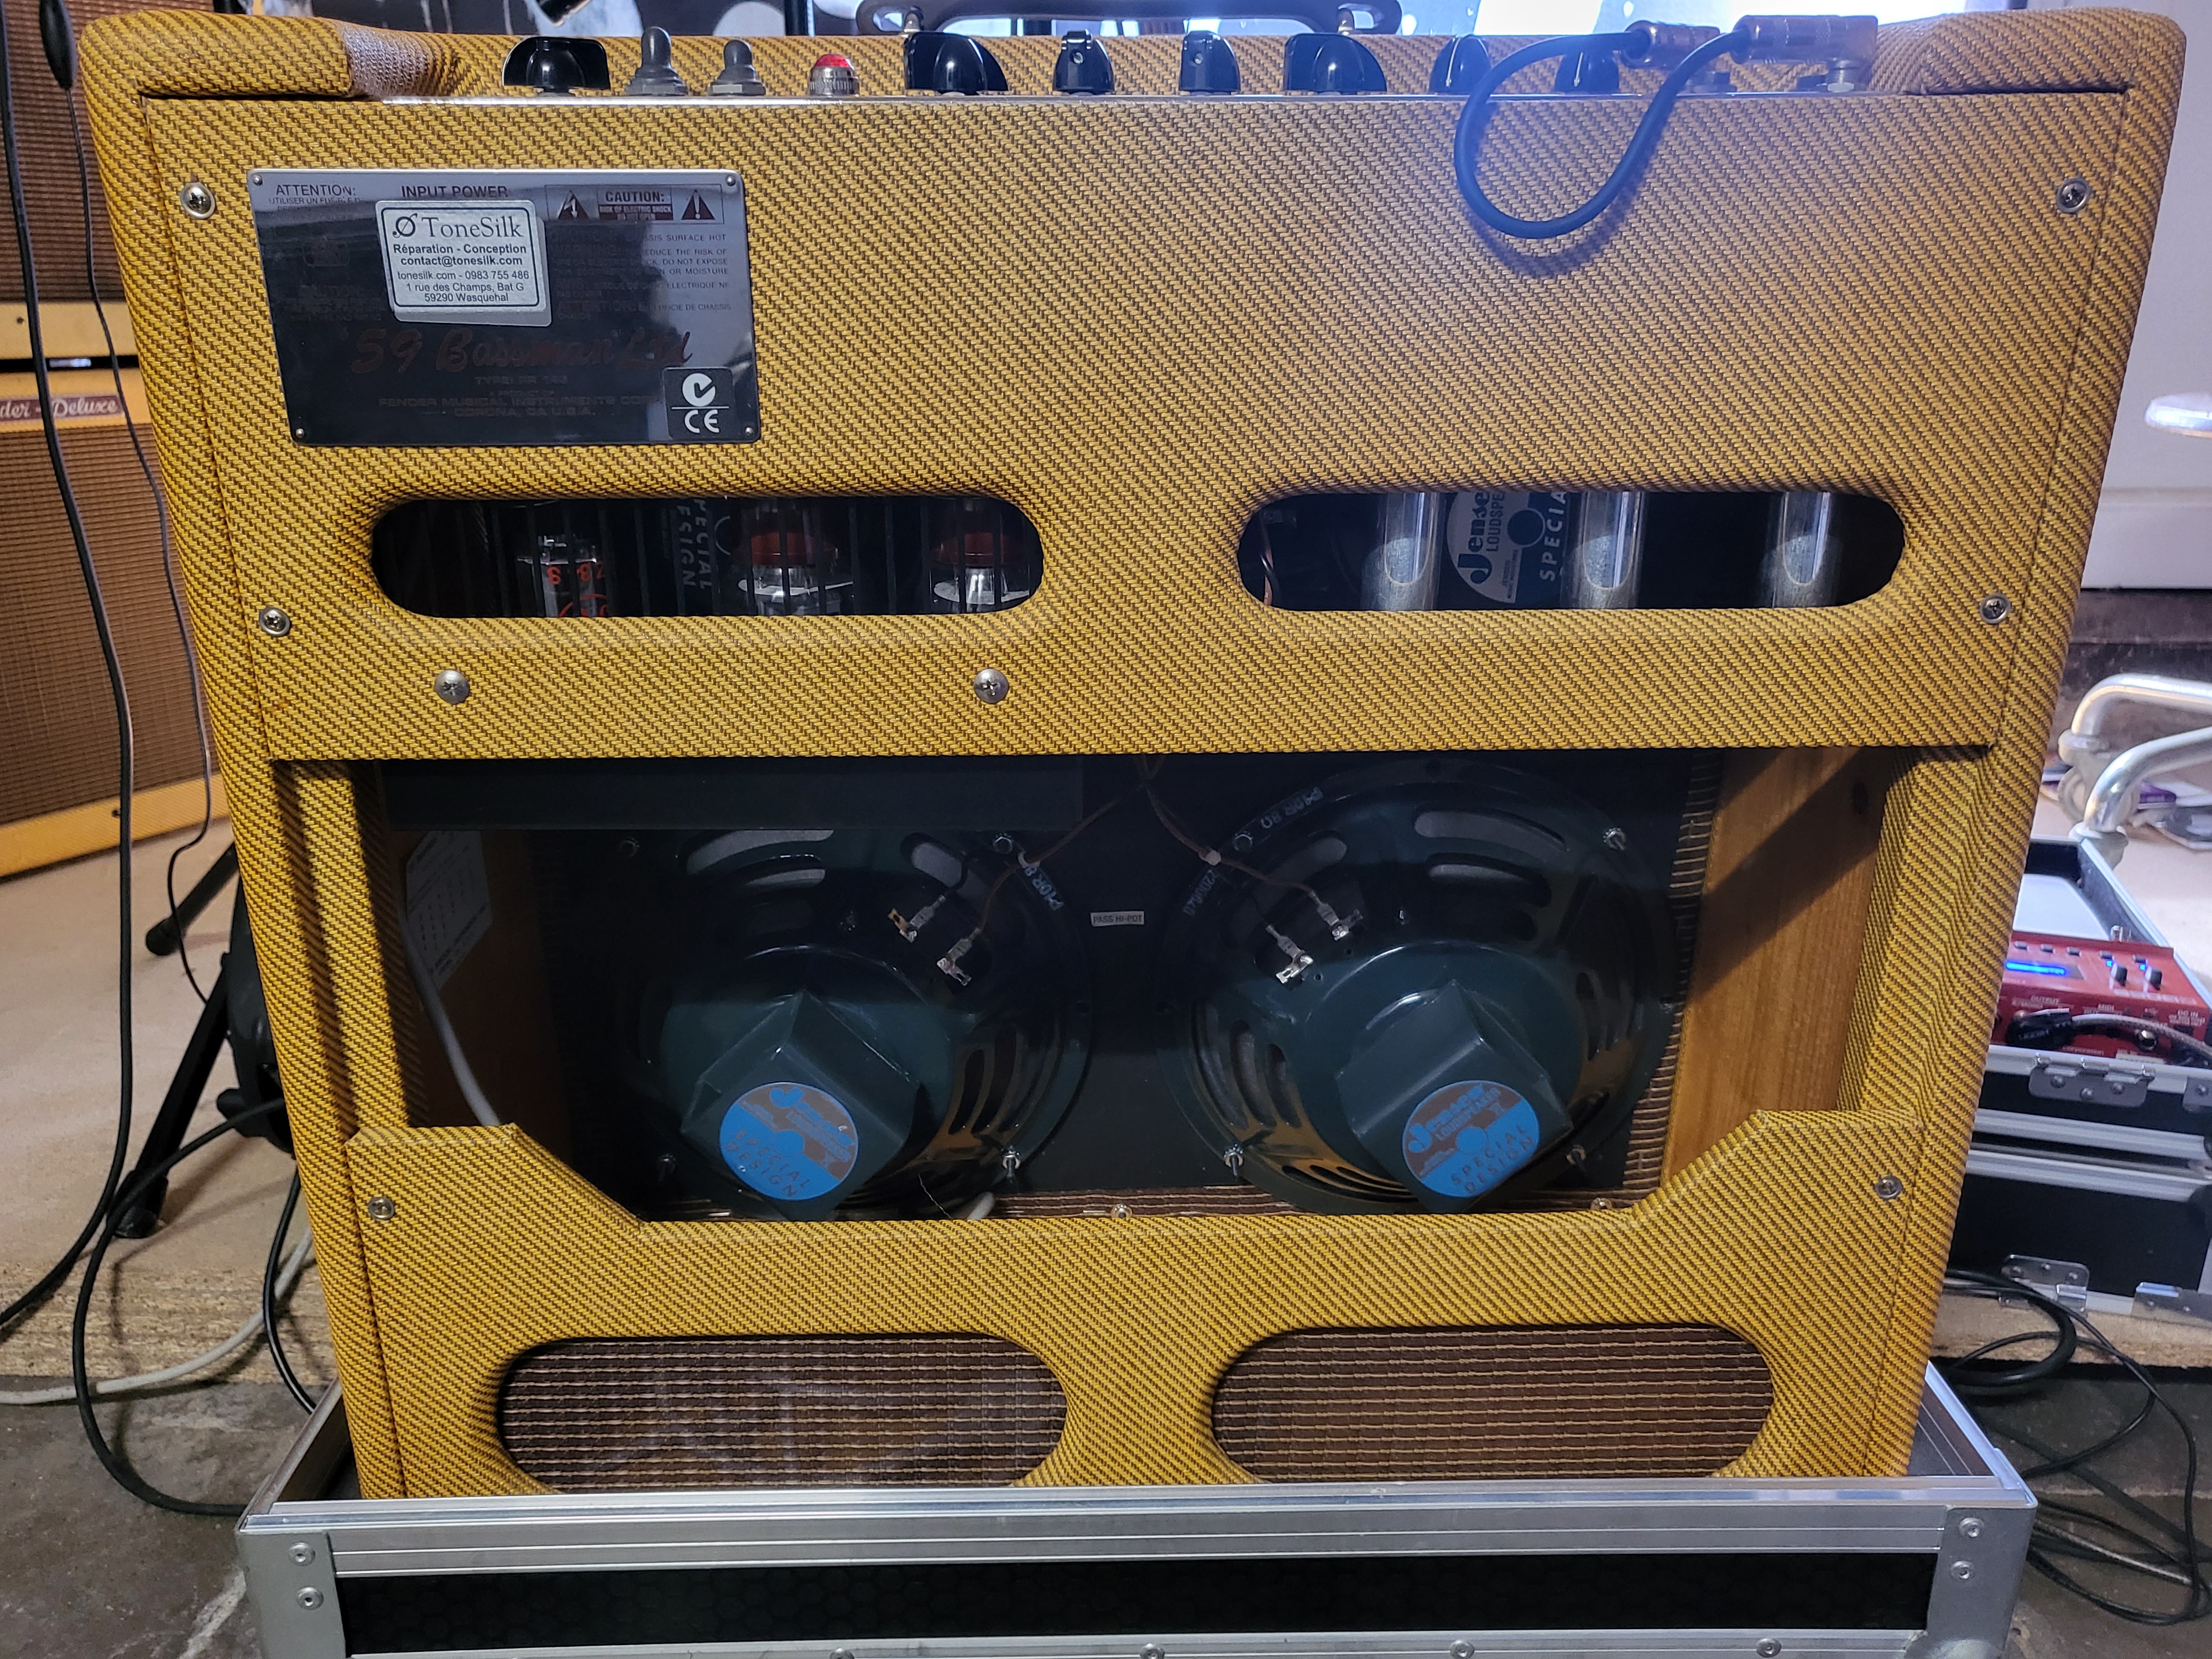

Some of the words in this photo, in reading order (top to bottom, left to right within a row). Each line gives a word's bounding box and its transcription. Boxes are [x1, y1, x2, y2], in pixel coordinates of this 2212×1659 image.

[276, 185, 356, 196] ATTENTION:
[401, 185, 447, 197] INPUT
[452, 186, 508, 197] POWER
[605, 191, 665, 202] CAUTION:
[421, 216, 524, 238] ToneSilk
[393, 244, 453, 255] Réparation
[463, 244, 527, 255] Conception
[400, 255, 523, 267] contact@tonesilk.com
[398, 271, 456, 280] tonesilk.com
[465, 271, 489, 280] 0983
[491, 271, 509, 280] 755
[512, 270, 529, 280] 486
[406, 283, 411, 291] 1
[433, 283, 450, 291] des
[452, 283, 495, 293] Champs,
[497, 283, 514, 291] Bat
[516, 283, 524, 291] G
[424, 293, 453, 302] 59290
[457, 293, 509, 304] Wasquehal
[54, 396, 118, 418] Deluxe
[1093, 913, 1113, 924] PASS
[1115, 912, 1142, 923] HI-POT
[1451, 1124, 1527, 1185] SPECIAL
